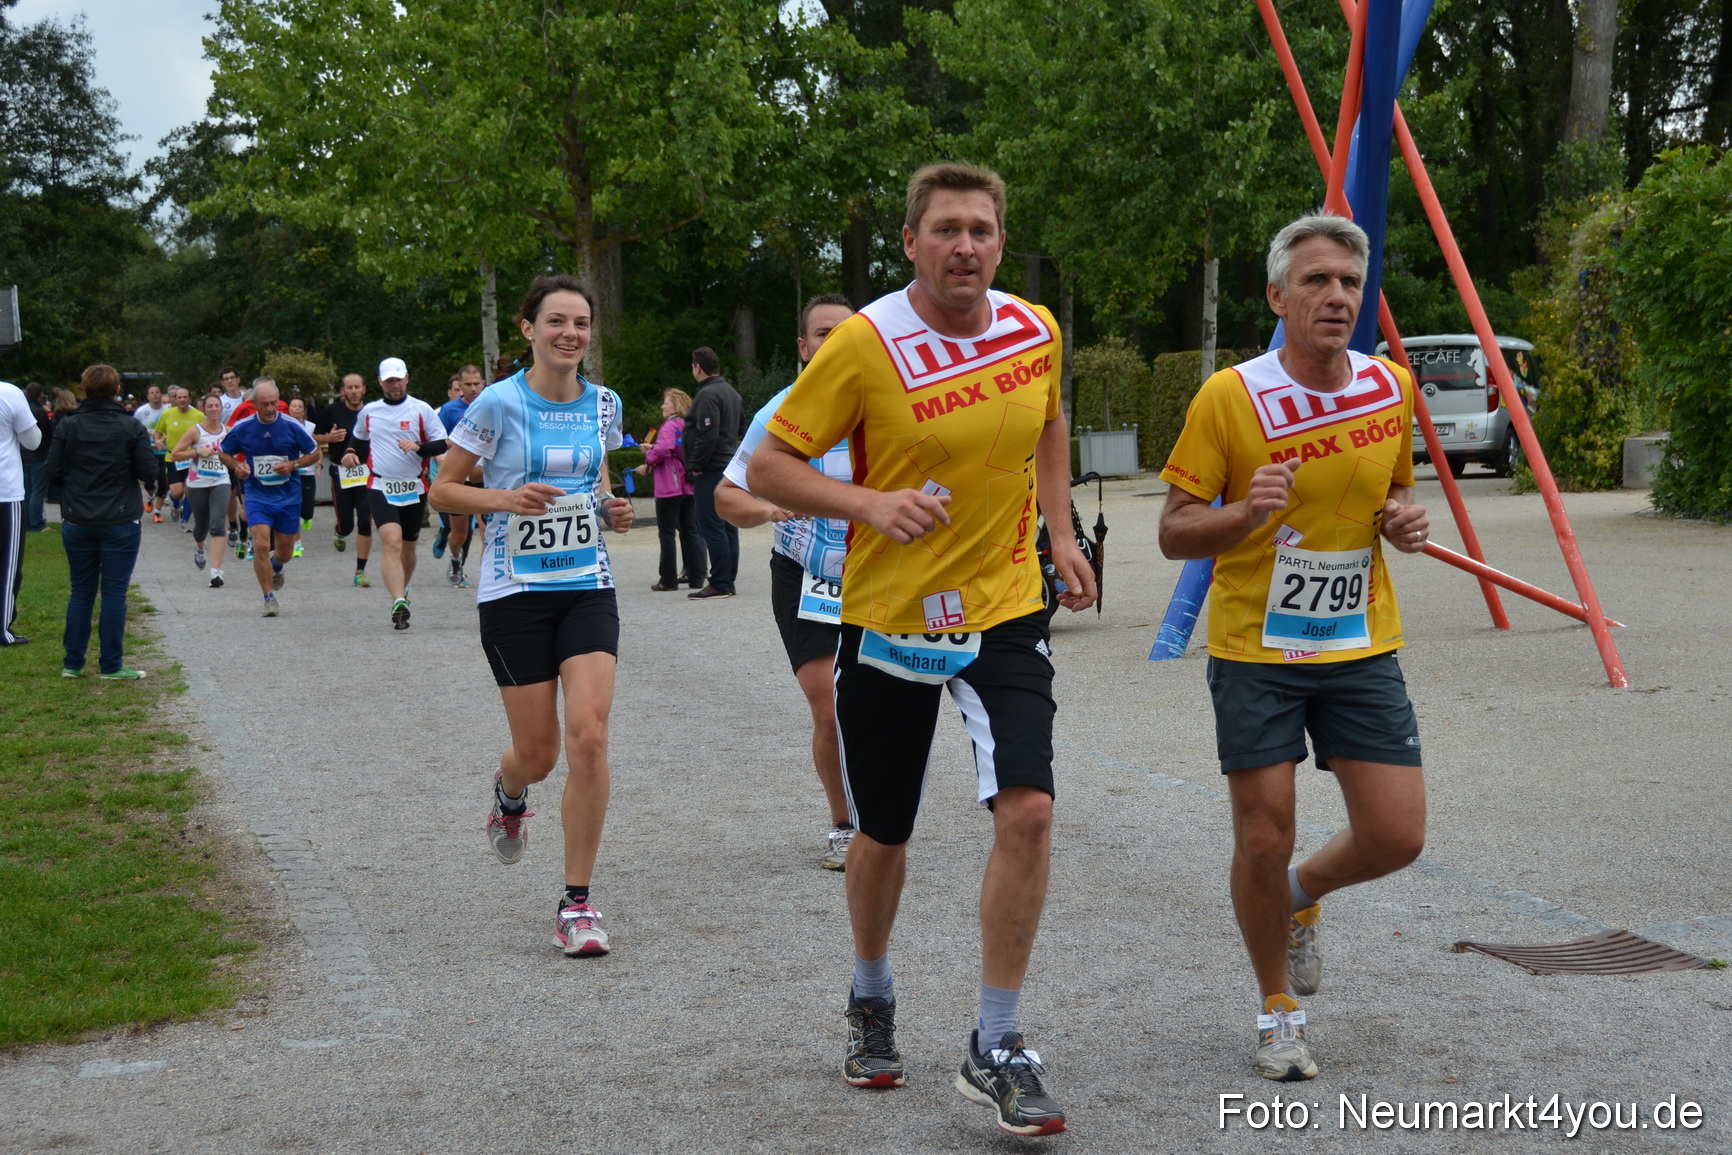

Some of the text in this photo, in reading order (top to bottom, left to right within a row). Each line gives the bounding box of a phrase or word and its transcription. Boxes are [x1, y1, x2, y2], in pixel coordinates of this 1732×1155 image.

[911, 354, 1053, 423] MAX BÖGL
[538, 411, 592, 423] VIERTL
[538, 422, 593, 432] DESIGN GmbH
[1349, 415, 1403, 449] BÖGL
[201, 459, 224, 471] 2054
[258, 462, 272, 475] 22
[345, 466, 364, 478] 258
[386, 481, 416, 495] 3030
[518, 514, 592, 551] 2575
[828, 531, 845, 540] rau
[494, 514, 509, 581] VIERTL
[540, 555, 575, 570] Katrin
[1278, 554, 1360, 571] PARTL Neumarkt
[811, 575, 842, 599] 26
[1280, 573, 1363, 612] 2799
[1301, 621, 1338, 638] Josef
[889, 647, 946, 672] Richard
